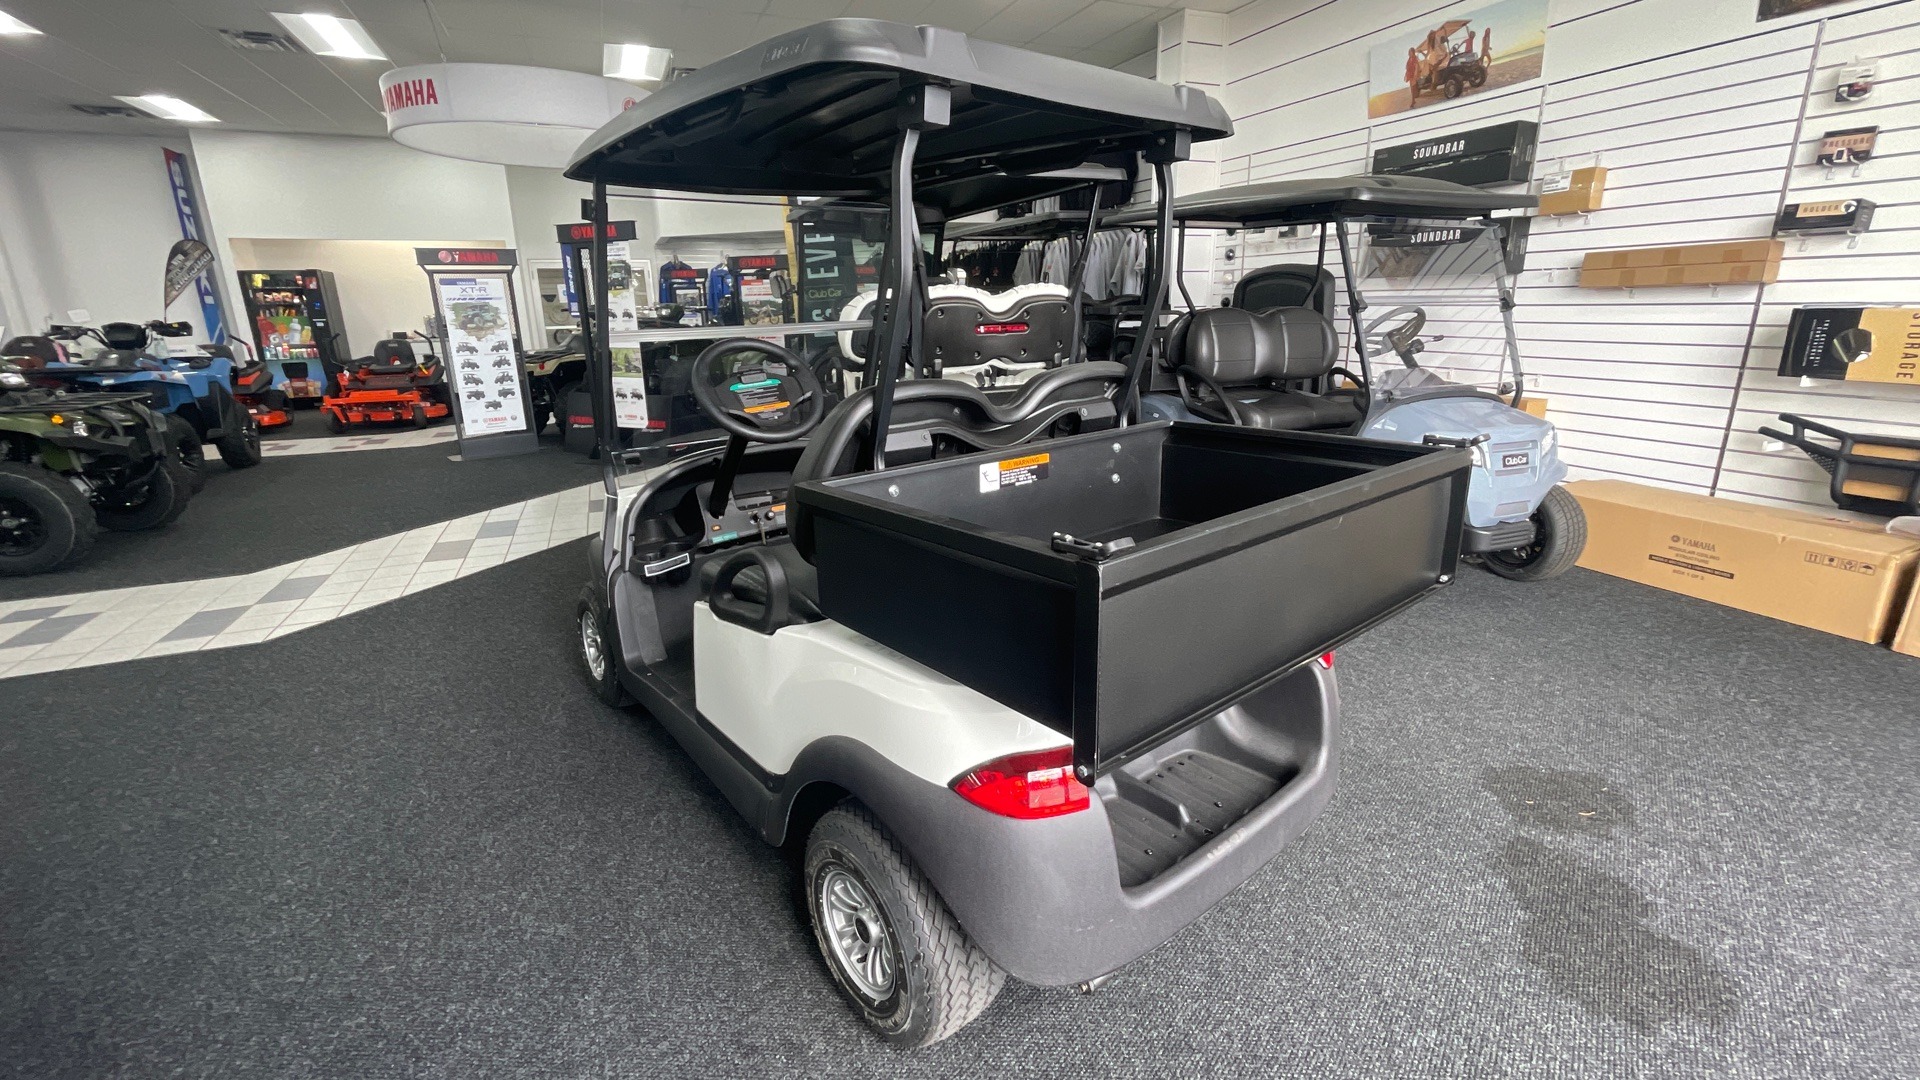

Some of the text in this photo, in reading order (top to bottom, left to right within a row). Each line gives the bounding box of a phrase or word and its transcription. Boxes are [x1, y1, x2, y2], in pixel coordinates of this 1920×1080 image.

[384, 78, 438, 114] YAMAHA
[1413, 140, 1465, 160] SOUNDBAR
[170, 160, 215, 304] SUZKI
[581, 224, 617, 238] YAHA
[1411, 229, 1461, 243] SOUNDBAR
[452, 251, 498, 262] YAMAHA
[803, 221, 839, 279] EVE
[747, 257, 776, 268] YAMAHA
[460, 286, 488, 294] XT-R
[1013, 456, 1040, 467] WARNING
[1682, 537, 1716, 552] YAMAHA
